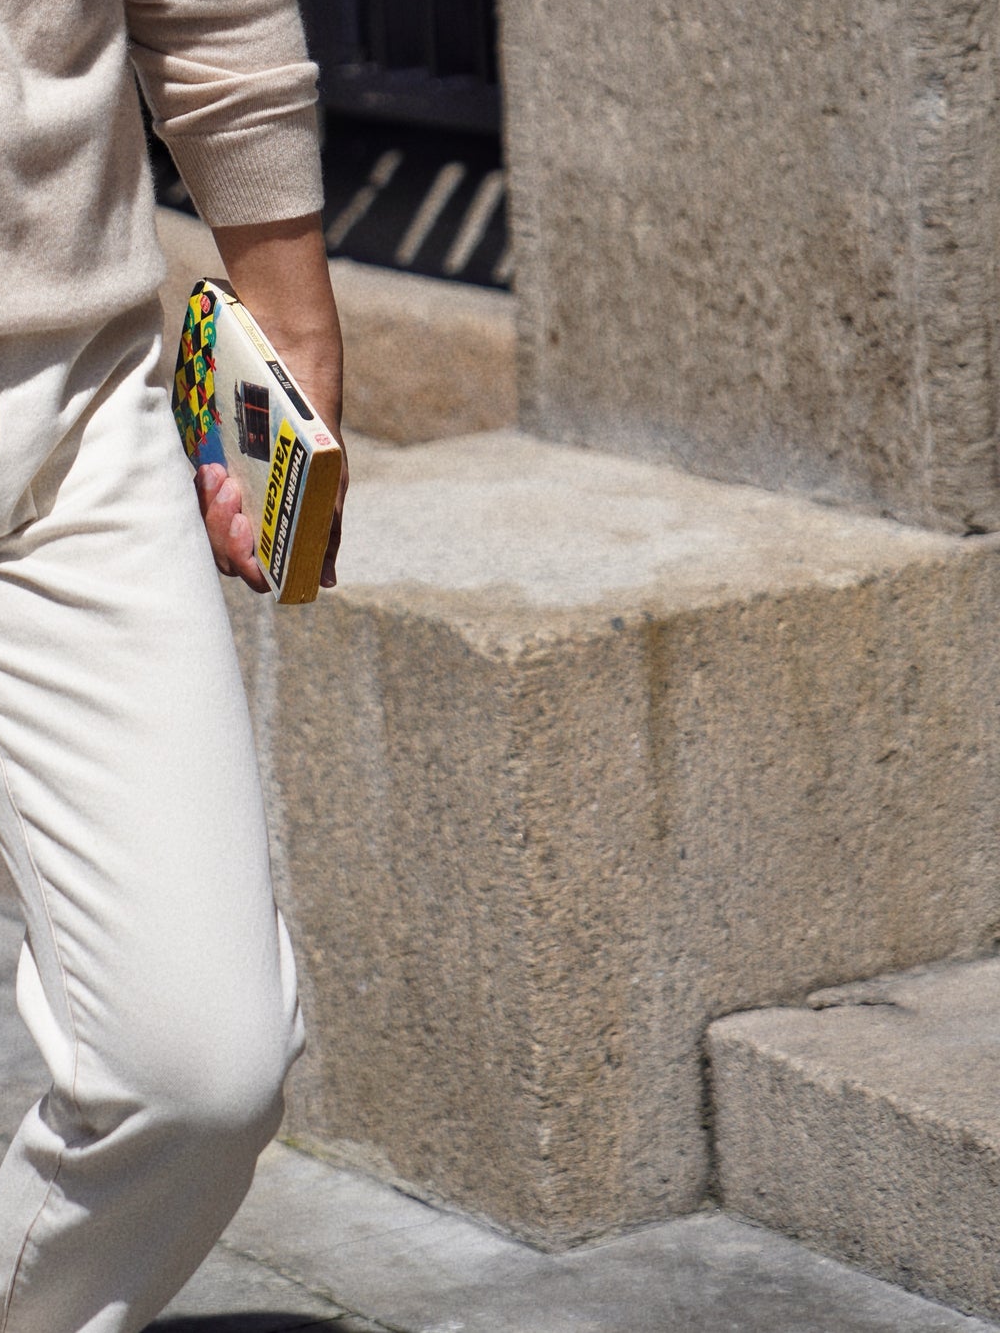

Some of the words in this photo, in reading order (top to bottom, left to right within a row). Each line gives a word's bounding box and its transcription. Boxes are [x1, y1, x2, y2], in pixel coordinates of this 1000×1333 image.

[264, 434, 290, 526] Vatican
[284, 446, 303, 516] THIERRY
[260, 528, 271, 560] III
[272, 513, 289, 580] BRETON
